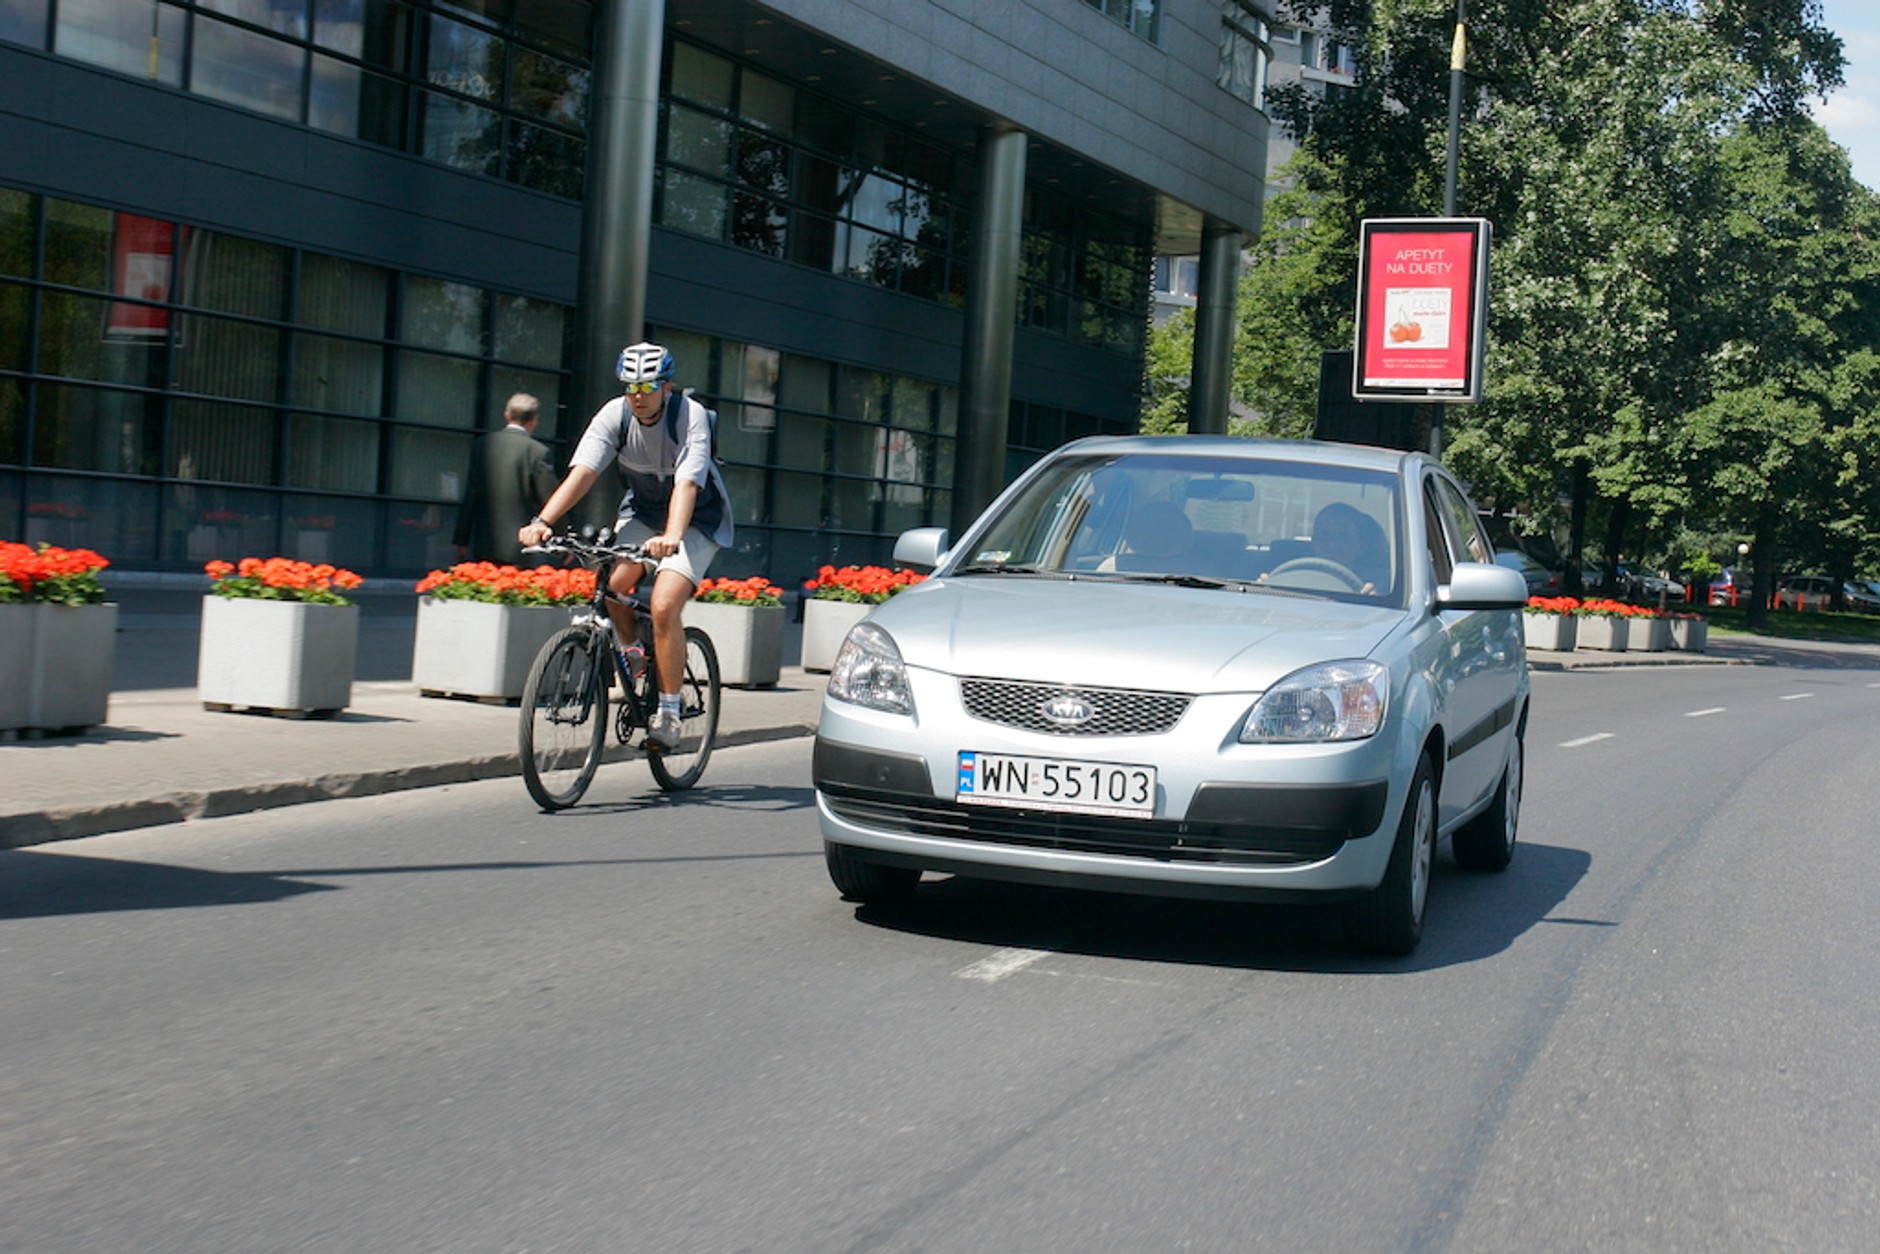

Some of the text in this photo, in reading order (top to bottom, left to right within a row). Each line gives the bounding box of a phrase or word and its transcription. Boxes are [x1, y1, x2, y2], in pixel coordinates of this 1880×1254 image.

[1395, 249, 1444, 260] APETYT
[1386, 262, 1453, 274] NA DUETY
[960, 759, 1149, 804] PL WN 55103
